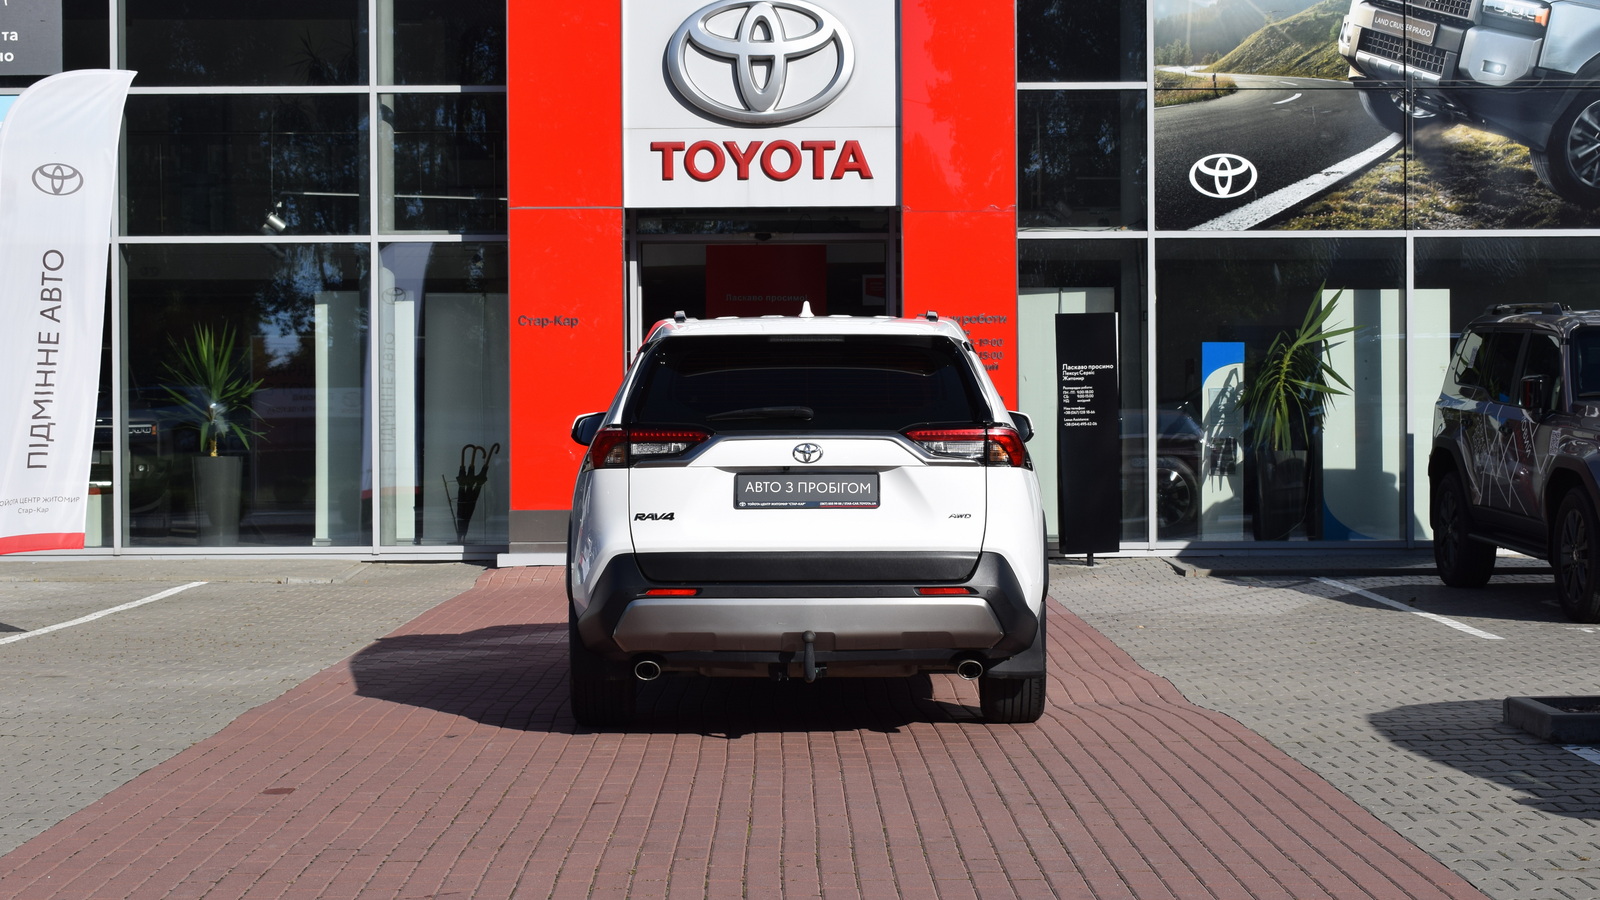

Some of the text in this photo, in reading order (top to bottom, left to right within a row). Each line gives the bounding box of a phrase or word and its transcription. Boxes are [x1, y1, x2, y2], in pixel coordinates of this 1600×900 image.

[1374, 17, 1389, 26] LAND
[1412, 26, 1431, 37] PRADO
[650, 140, 873, 182] TOYOTA
[518, 315, 579, 328] Стар-Кар
[963, 313, 1007, 326] роботи
[27, 249, 64, 469] ПІДМІННЕ АВТО
[745, 481, 781, 493] АВТО
[797, 481, 871, 494] ПРОБІГОМ
[0, 499, 18, 507] ОЙОТА
[634, 512, 675, 521] RAV4
